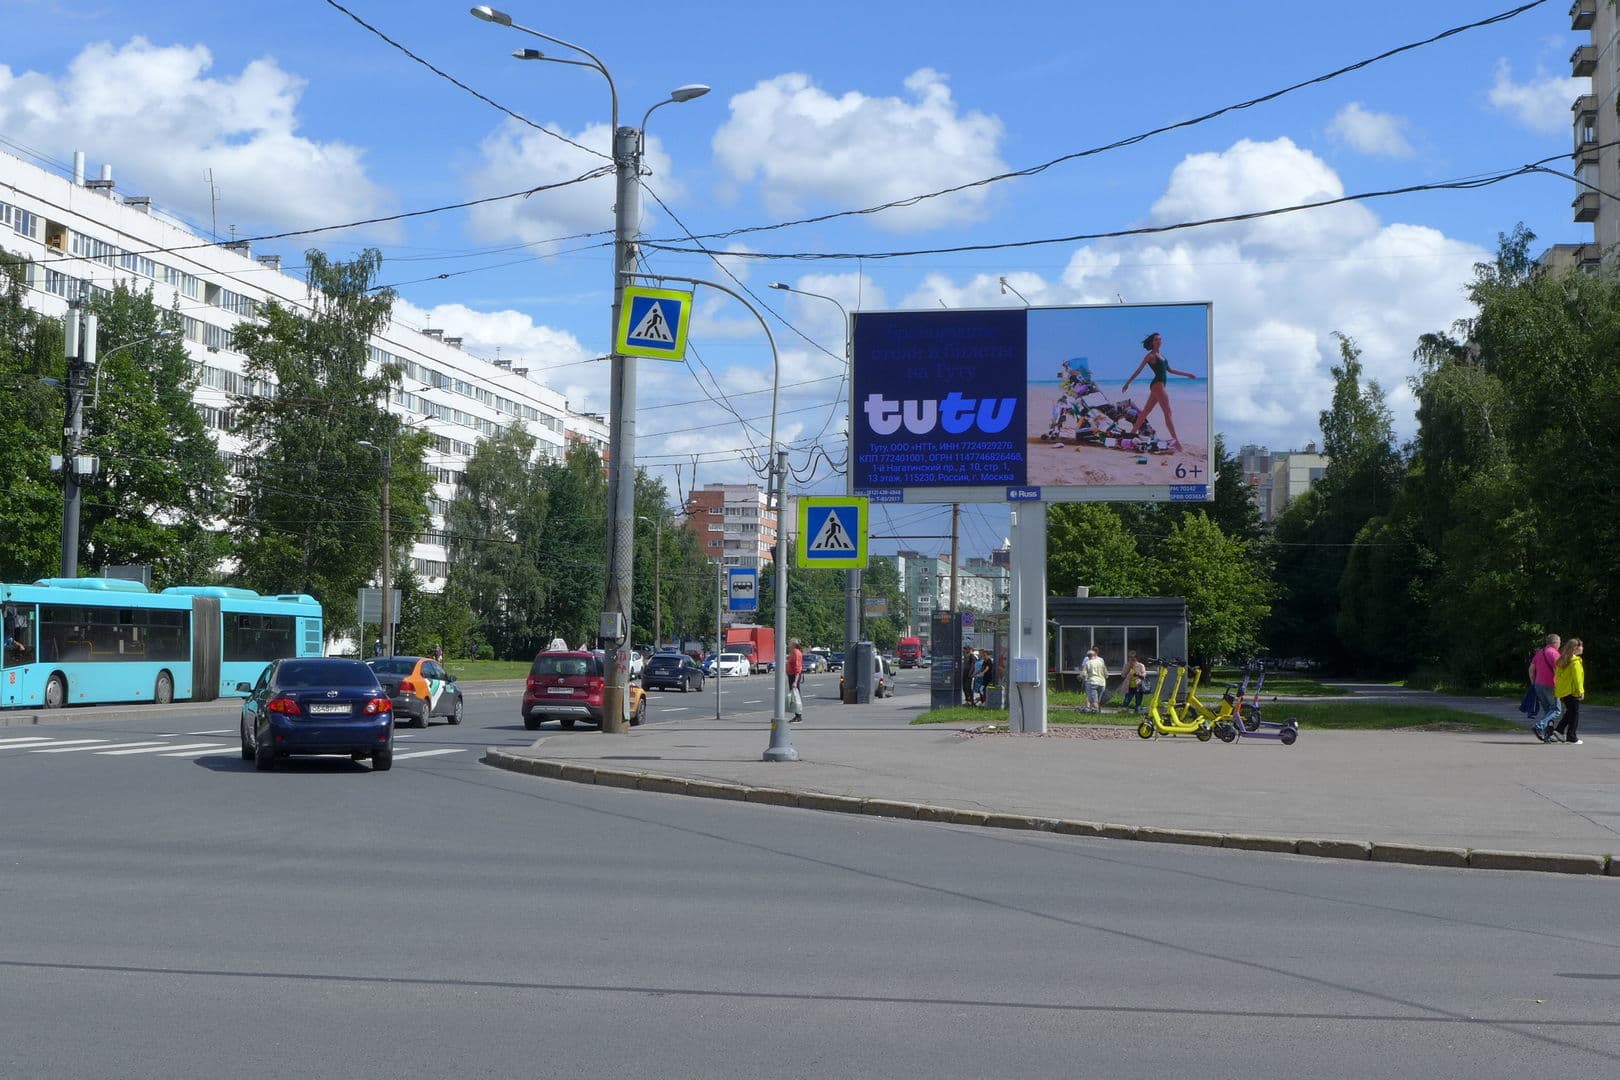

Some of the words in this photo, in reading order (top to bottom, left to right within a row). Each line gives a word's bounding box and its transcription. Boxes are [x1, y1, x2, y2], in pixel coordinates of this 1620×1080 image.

[864, 392, 1017, 435] tutu
[890, 443, 908, 451] ООО
[939, 442, 959, 450] ИНН
[859, 455, 879, 463] КПП
[928, 453, 953, 462] ОГРН
[1175, 463, 1202, 479] 6+
[980, 473, 1015, 481] Москва
[1018, 490, 1038, 498] Russ
